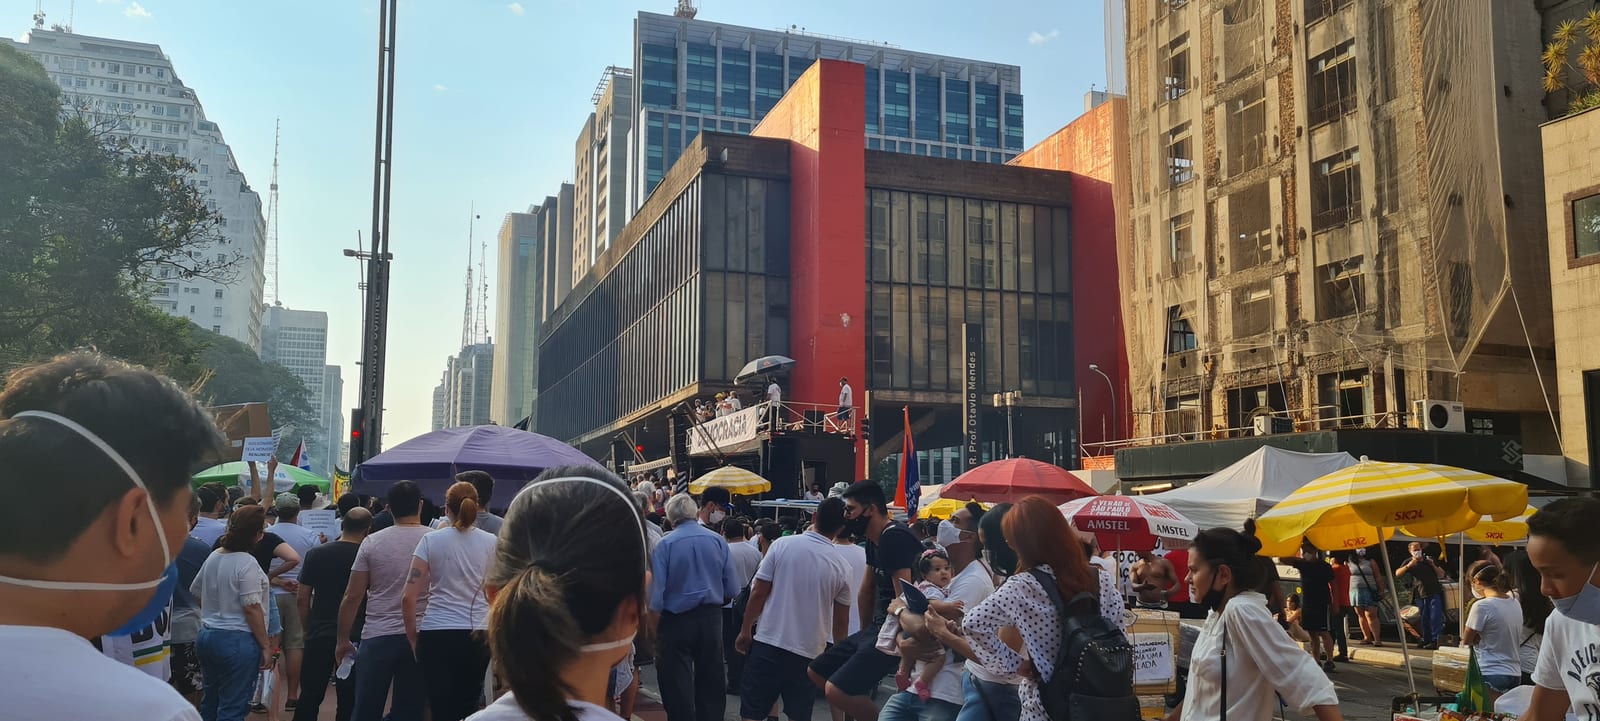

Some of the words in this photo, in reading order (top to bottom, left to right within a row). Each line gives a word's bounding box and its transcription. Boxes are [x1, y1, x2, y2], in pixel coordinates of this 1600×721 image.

[967, 351, 976, 390] Mendes
[968, 428, 977, 453] Prof.
[968, 455, 977, 465] R.
[1091, 505, 1106, 513] SÃO
[1394, 510, 1424, 521] SKOL
[1087, 519, 1131, 531] AMSTEL
[1156, 523, 1190, 537] AMSTEL
